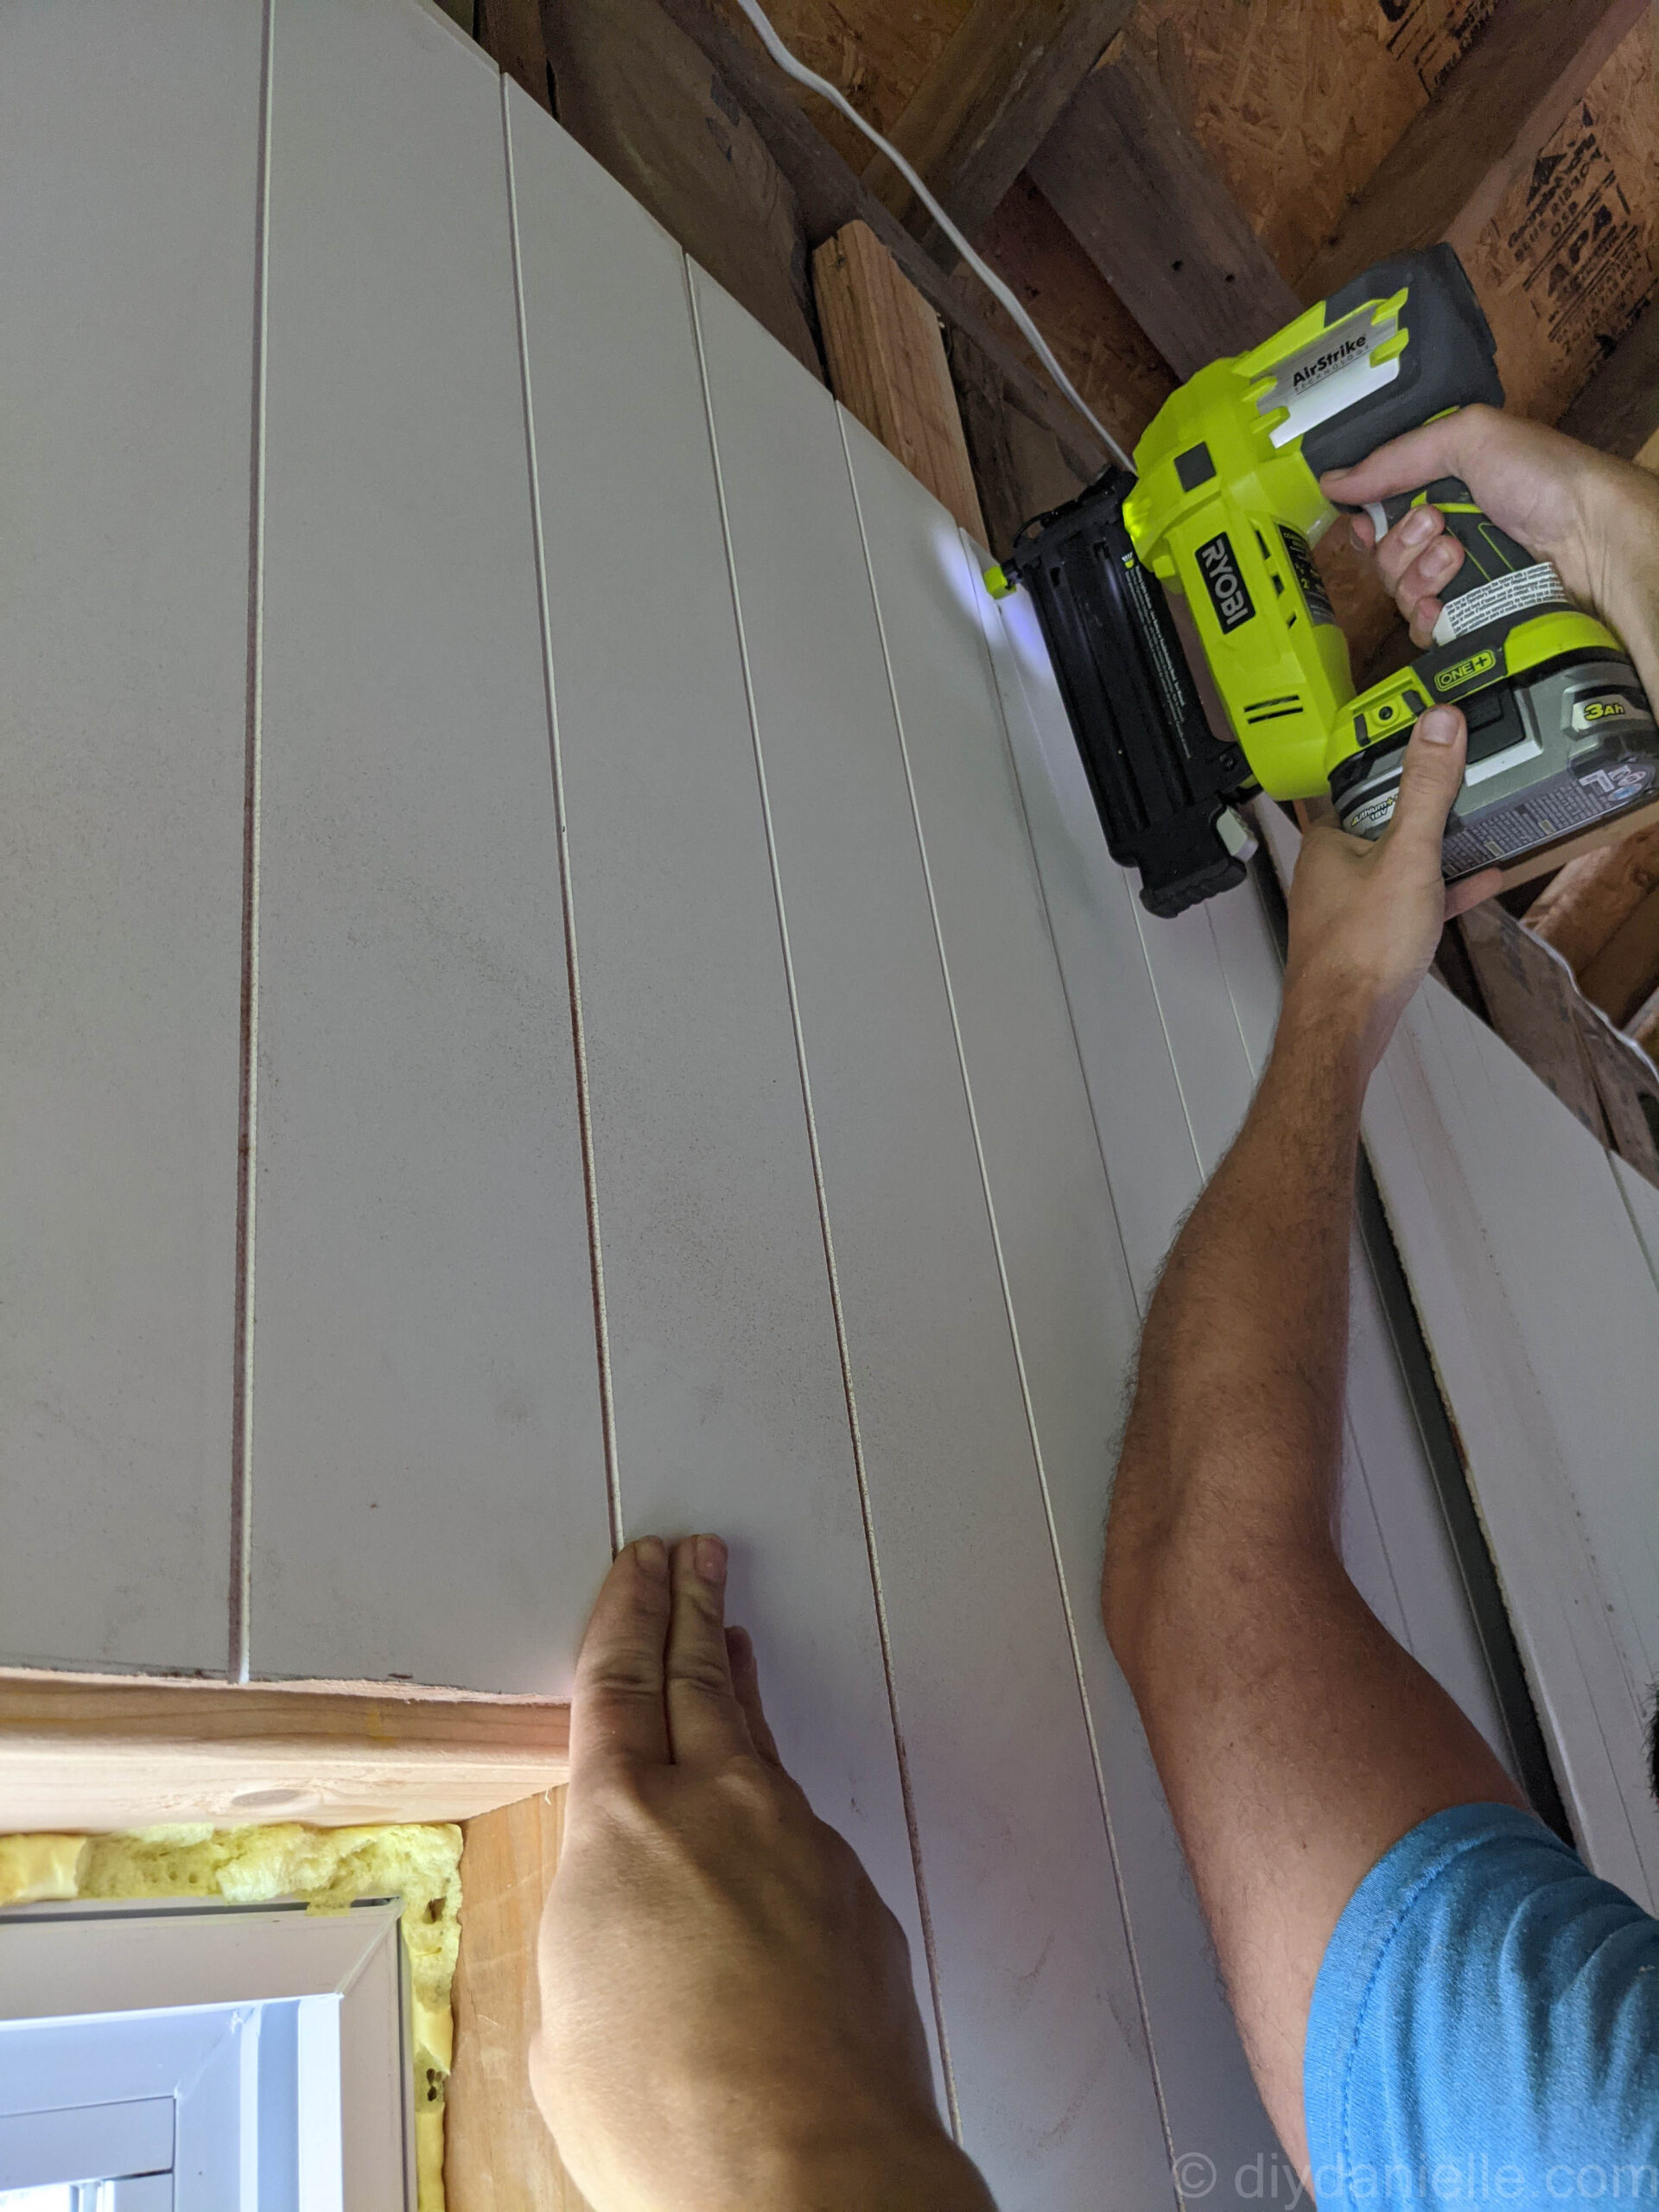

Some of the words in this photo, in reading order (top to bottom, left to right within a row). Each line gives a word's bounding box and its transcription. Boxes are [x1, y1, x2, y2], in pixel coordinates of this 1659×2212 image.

[1294, 336, 1366, 387] AirStrike
[1202, 538, 1249, 625] RYOBI
[1584, 702, 1625, 721] 3Ah
[1370, 807, 1389, 821] 18V
